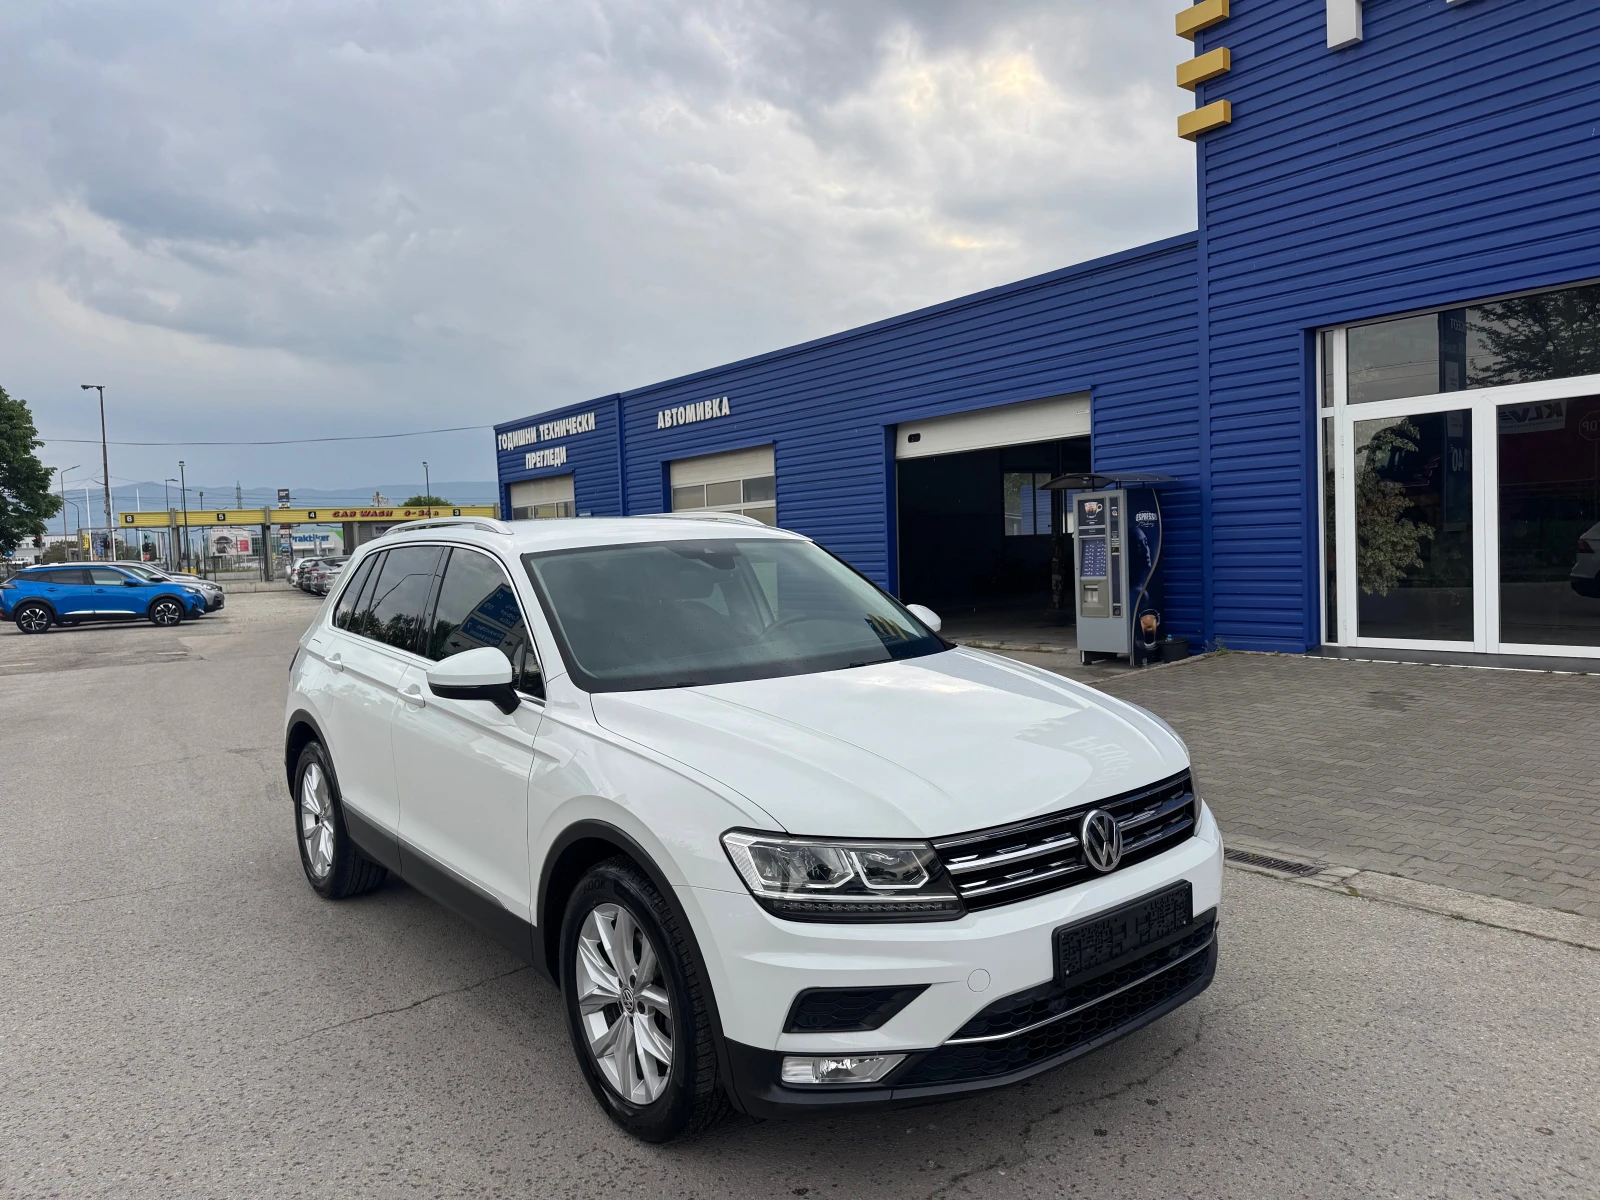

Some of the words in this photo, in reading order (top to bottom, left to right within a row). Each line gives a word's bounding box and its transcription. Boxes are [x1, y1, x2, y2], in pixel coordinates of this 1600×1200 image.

[657, 396, 730, 429] АВТОМИВКА
[498, 427, 537, 451] ГОДИШНИ
[539, 412, 595, 441] ТЕХНИЧЕСКИ
[525, 446, 566, 469] ПРЕГЛЕДИ
[332, 510, 357, 518] CAR
